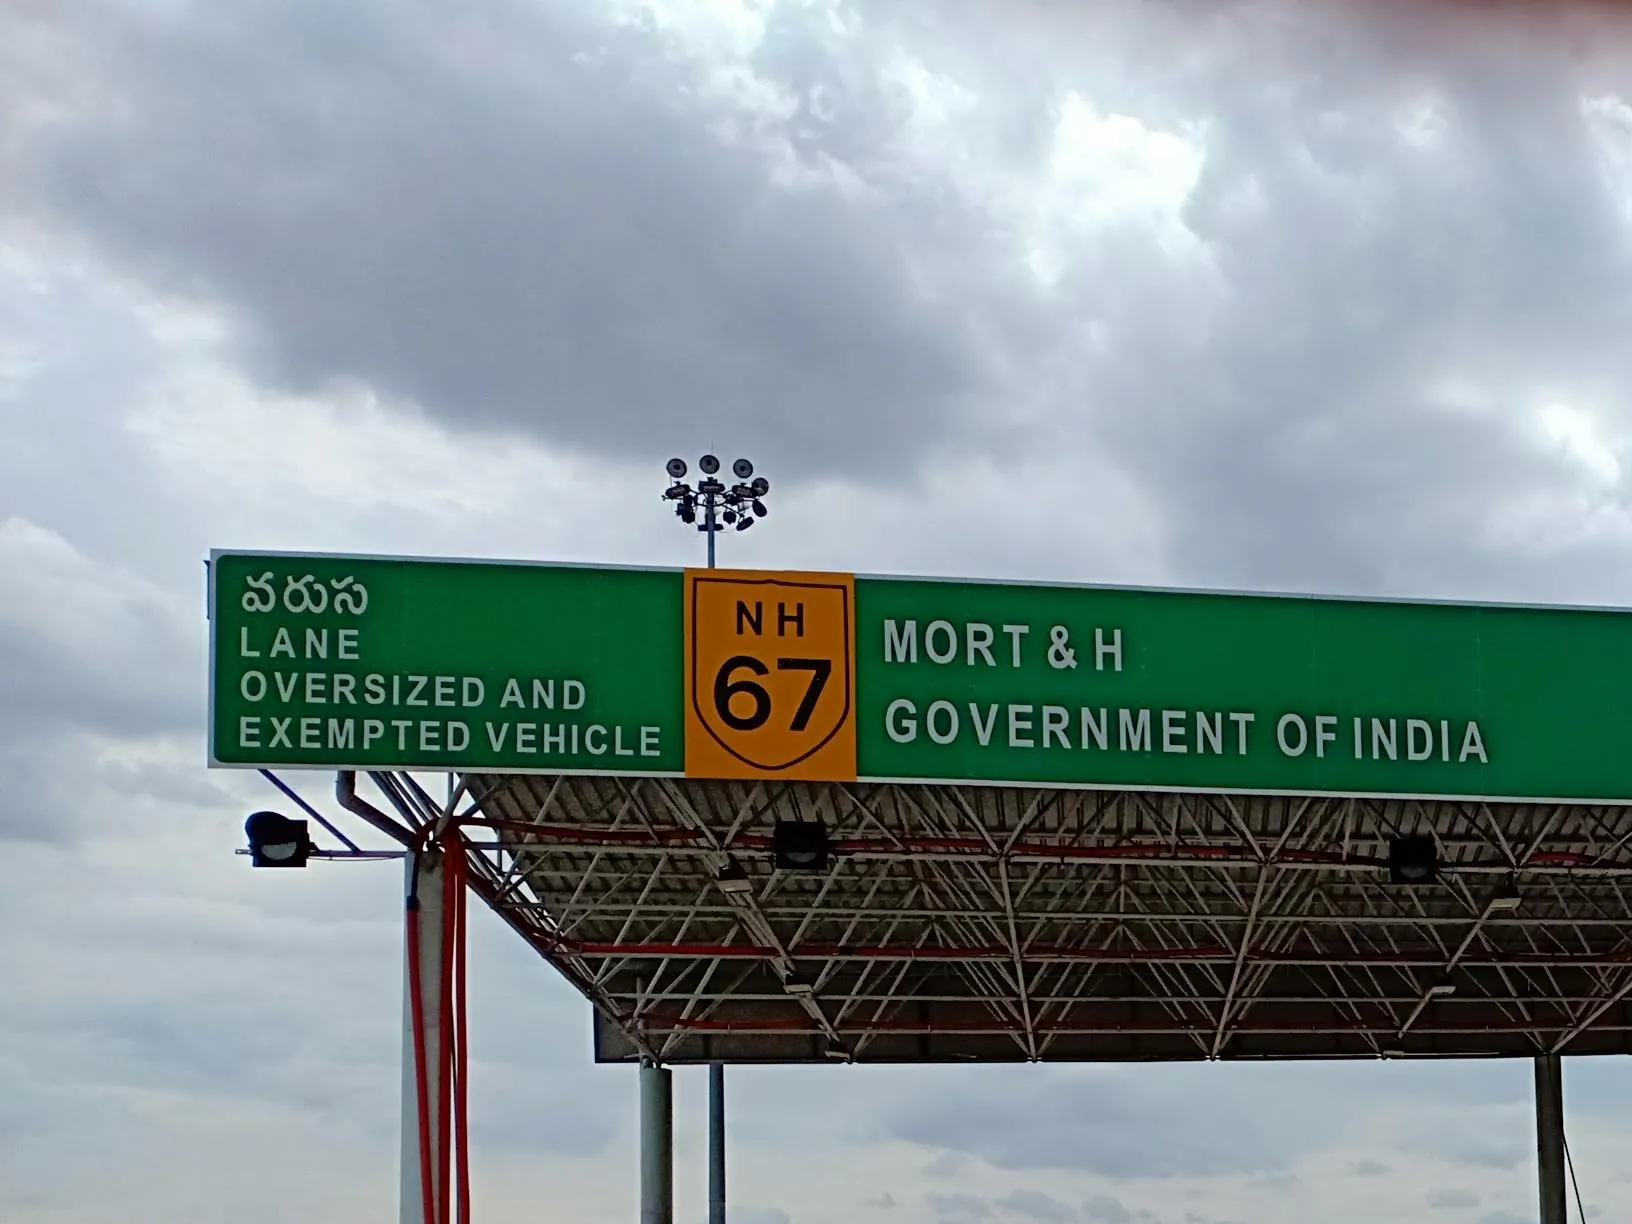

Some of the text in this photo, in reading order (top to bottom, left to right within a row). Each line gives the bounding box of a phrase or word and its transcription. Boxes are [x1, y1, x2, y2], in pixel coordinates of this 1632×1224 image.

[241, 571, 369, 615] వరుస
[735, 600, 804, 638] NH
[241, 626, 359, 660] LANE
[884, 619, 1123, 672] MORT & H
[240, 670, 587, 710] OVERSIZED AND
[713, 655, 832, 731] 67
[239, 716, 662, 757] EXEMPTED VEHICLE
[885, 698, 1489, 764] GOVERNMENT OF INDIA
